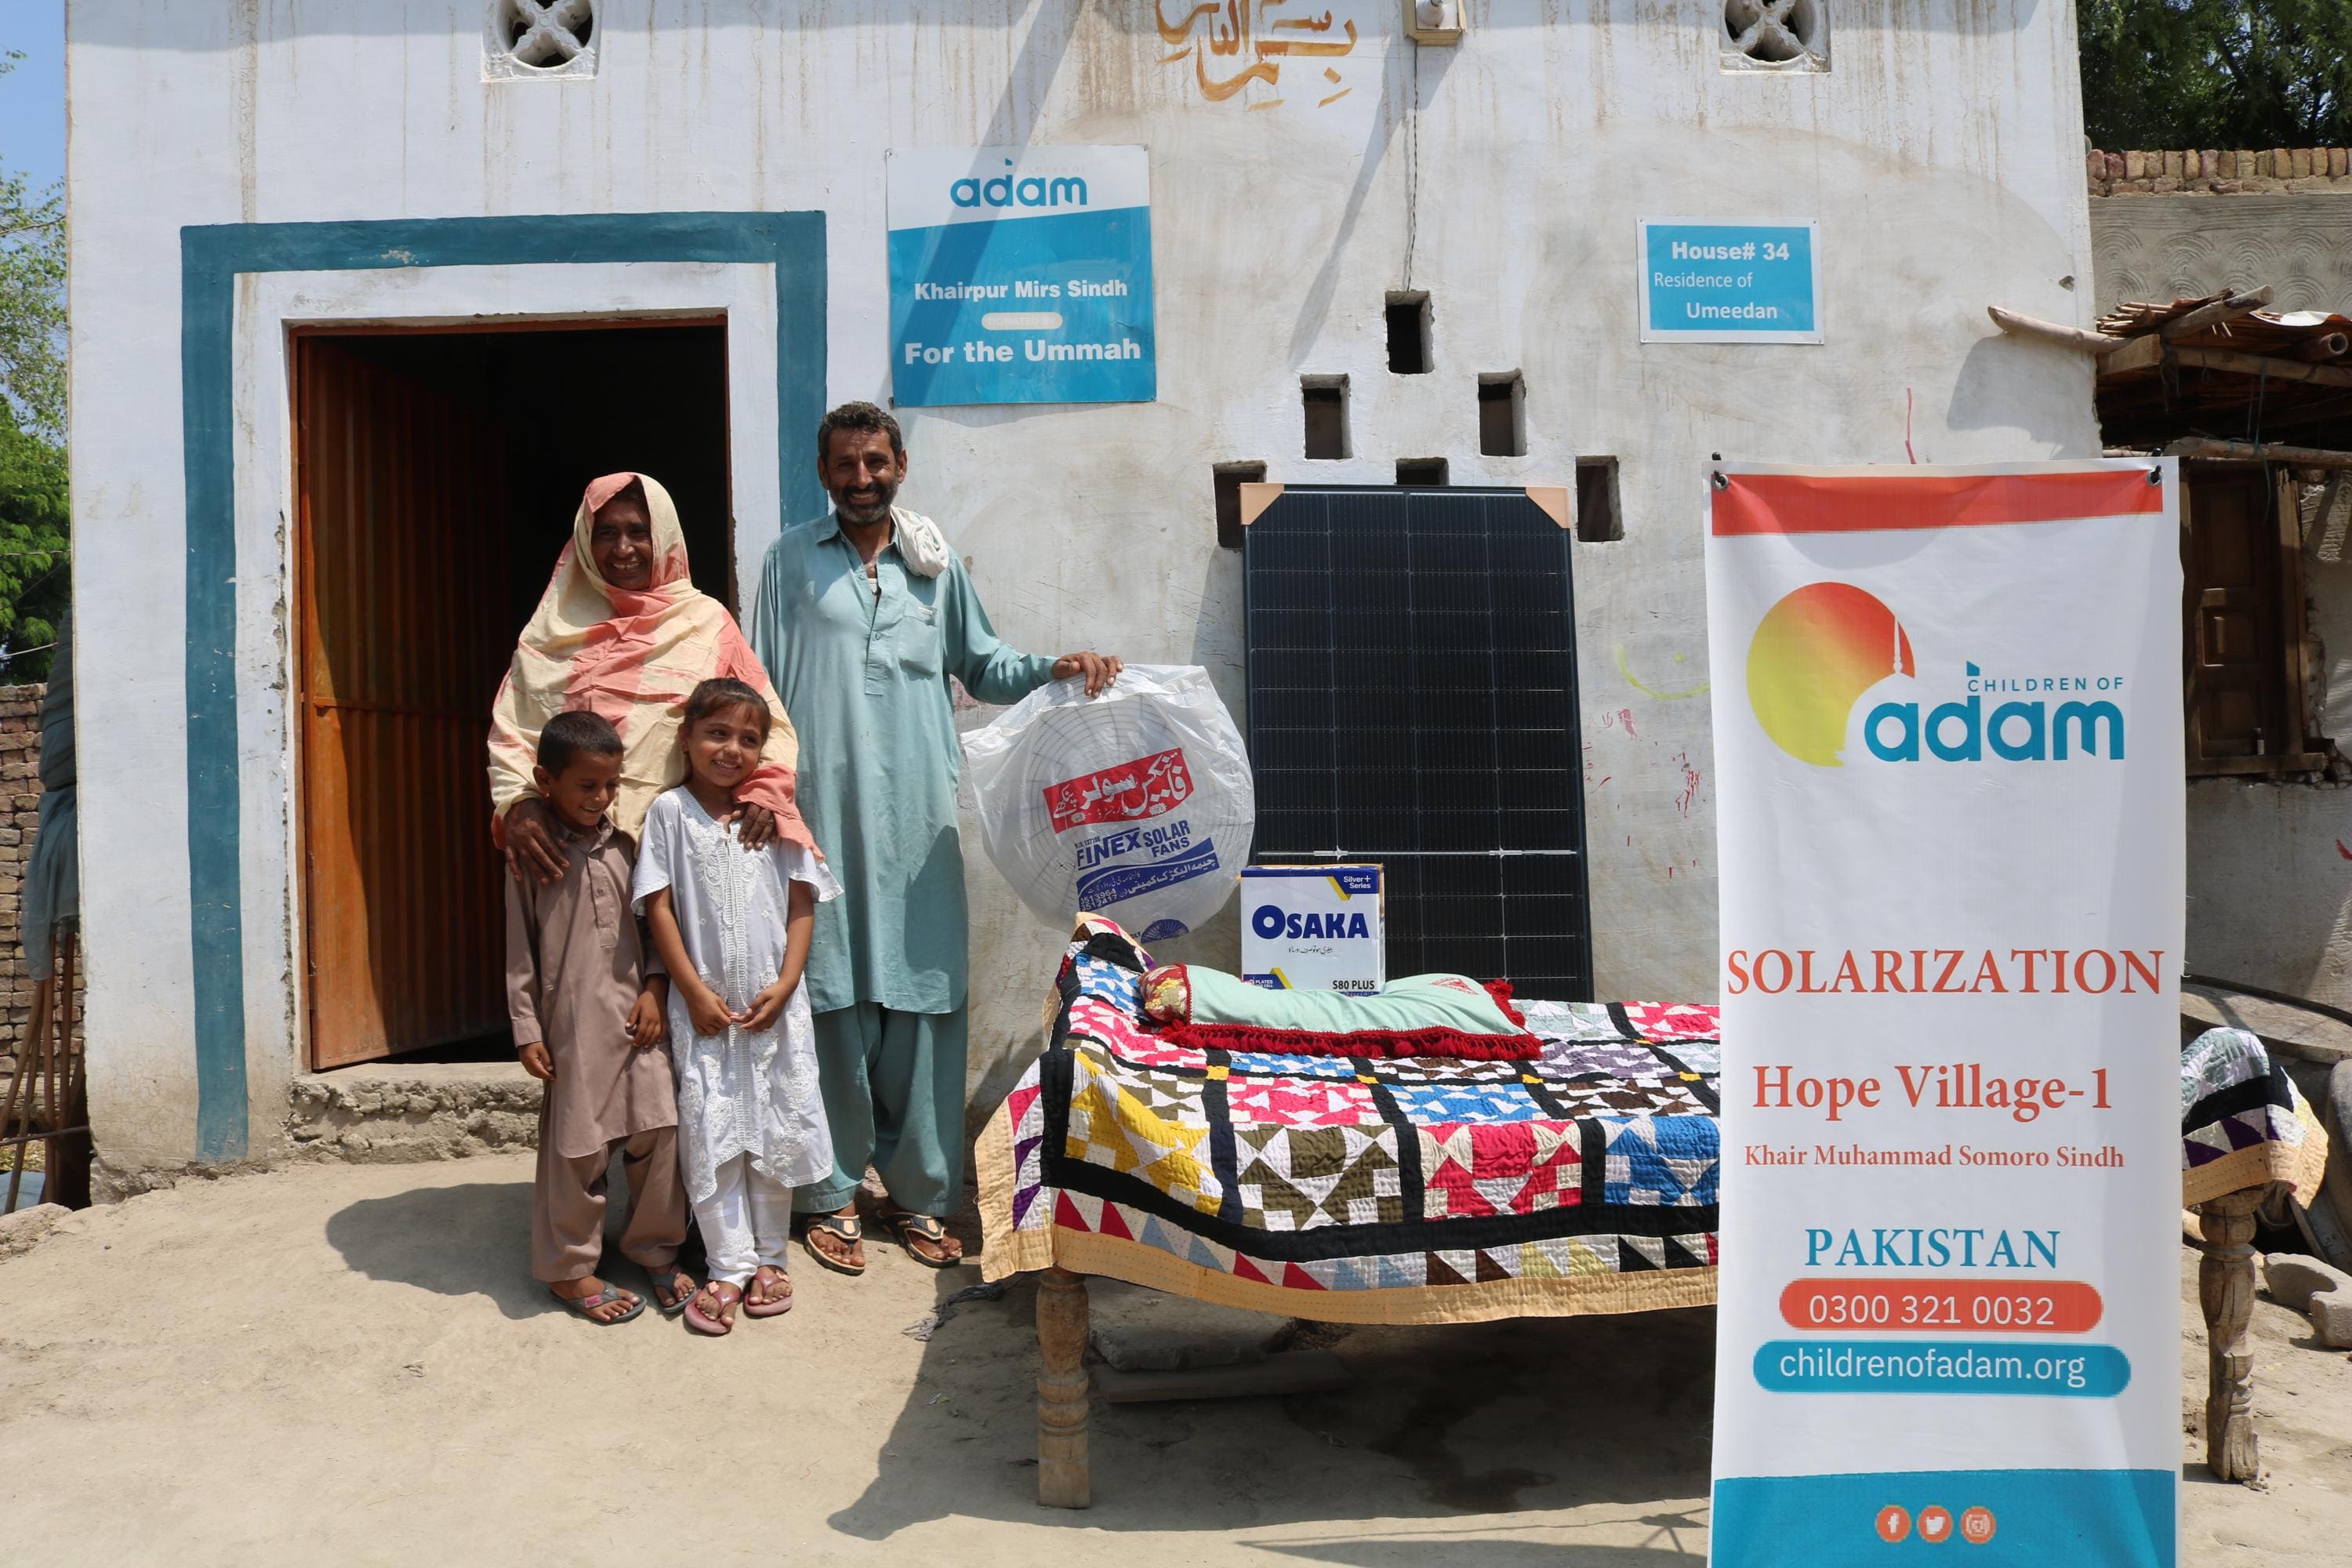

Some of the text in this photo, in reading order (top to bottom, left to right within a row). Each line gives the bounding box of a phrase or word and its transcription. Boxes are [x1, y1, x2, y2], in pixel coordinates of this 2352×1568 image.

[950, 158, 1087, 207] adam
[1671, 241, 1790, 260] House# 34
[915, 280, 1128, 303] Khairpur Mirs Sindh
[1653, 271, 1753, 288] Residence of
[1686, 302, 1778, 319] Umeedan
[905, 338, 1141, 365] For the Ummah
[1967, 677, 2125, 693] CHILDREN OF
[1864, 661, 2125, 762] adam
[1077, 819, 1191, 870] FINEX SOLAR
[1152, 837, 1190, 858] FANS
[1252, 905, 1370, 939] OSAKA
[1333, 980, 1375, 990] S80 PLUS
[1727, 948, 2164, 994] SOLARIZATION
[1752, 1063, 2112, 1123] Hope Village-1
[1744, 1145, 2125, 1167] Khair Muhammad Somoro Sindh
[1804, 1229, 2060, 1269] PAKISTAN
[1809, 1295, 2054, 1326] 0300 321 0032
[1780, 1348, 2086, 1388] childrenofadam.org
